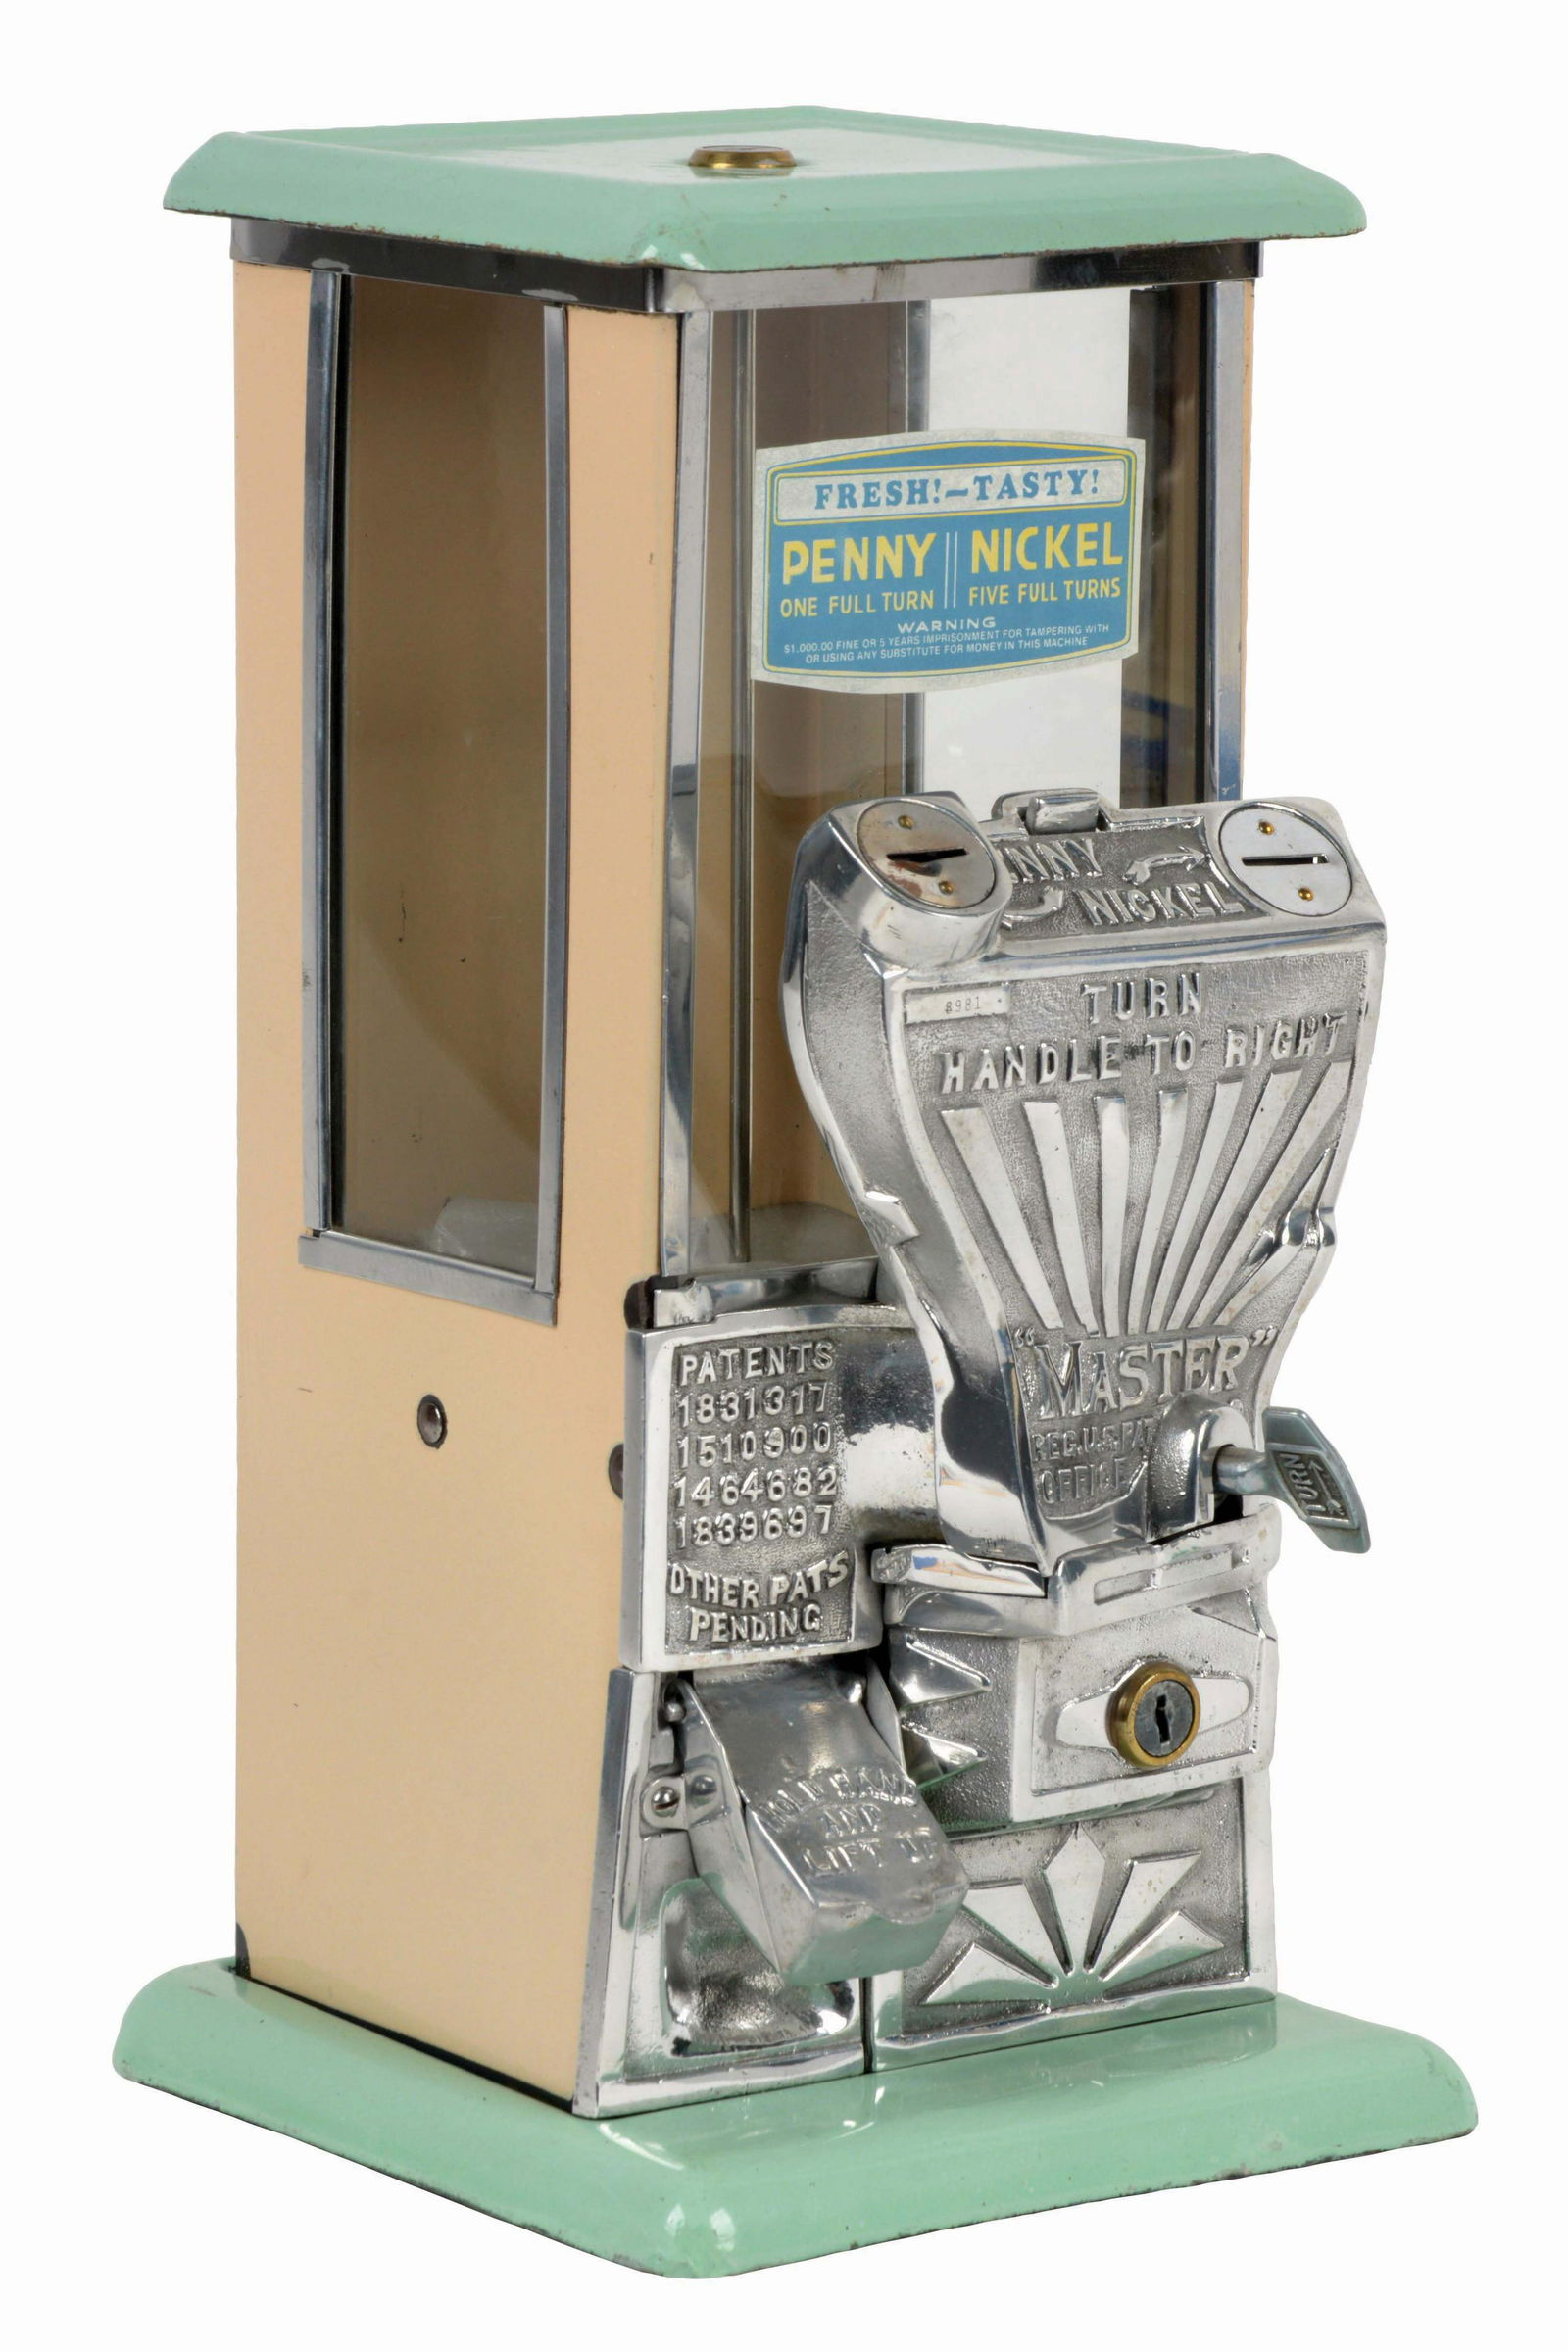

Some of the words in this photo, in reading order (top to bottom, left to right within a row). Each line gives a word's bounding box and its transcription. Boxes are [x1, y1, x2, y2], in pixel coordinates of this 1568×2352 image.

[782, 532, 938, 585] PENNY
[971, 521, 1124, 574] NICKEL
[780, 596, 818, 618] ONE
[828, 593, 877, 615] FULL
[882, 589, 935, 612] TURN
[968, 584, 1010, 607] FIVE
[1017, 581, 1058, 604] FULL
[1063, 576, 1122, 601] TURNS
[835, 639, 859, 651] FINE
[861, 638, 877, 649] OR
[879, 637, 885, 648] 5
[888, 635, 920, 647] YEARS
[923, 629, 999, 644] IMPRISONMENT
[1003, 628, 1022, 639] FOR
[1024, 623, 1082, 638] TAMPERING
[1085, 623, 1110, 635] WITH
[897, 616, 997, 634] WARNING
[805, 653, 820, 664] OR
[822, 651, 855, 663] USING
[857, 649, 877, 661] ANY
[880, 645, 941, 660] SUBSTITUTE
[943, 643, 963, 655] FOR
[966, 640, 1002, 653] MONEY
[1004, 638, 1016, 650] IN
[1018, 636, 1041, 649] THIS
[1043, 634, 1089, 648] MACHINE
[1072, 881, 1247, 927] NICKEL
[1081, 972, 1202, 1025] TURN
[941, 1034, 1123, 1094] HANDLE
[1145, 1029, 1196, 1076] TO
[1223, 1011, 1348, 1069] RIGHT
[680, 1341, 834, 1387] PATENTS
[678, 1382, 829, 1428] 1831317
[677, 1421, 833, 1469] 1510900
[673, 1464, 838, 1507] 1464682
[1278, 1452, 1327, 1512] TURN
[675, 1504, 833, 1549] 1839697
[668, 1560, 760, 1609] OTHER
[770, 1549, 849, 1606] PATS
[688, 1602, 822, 1642] PENDING
[803, 1838, 881, 1874] LIFT
